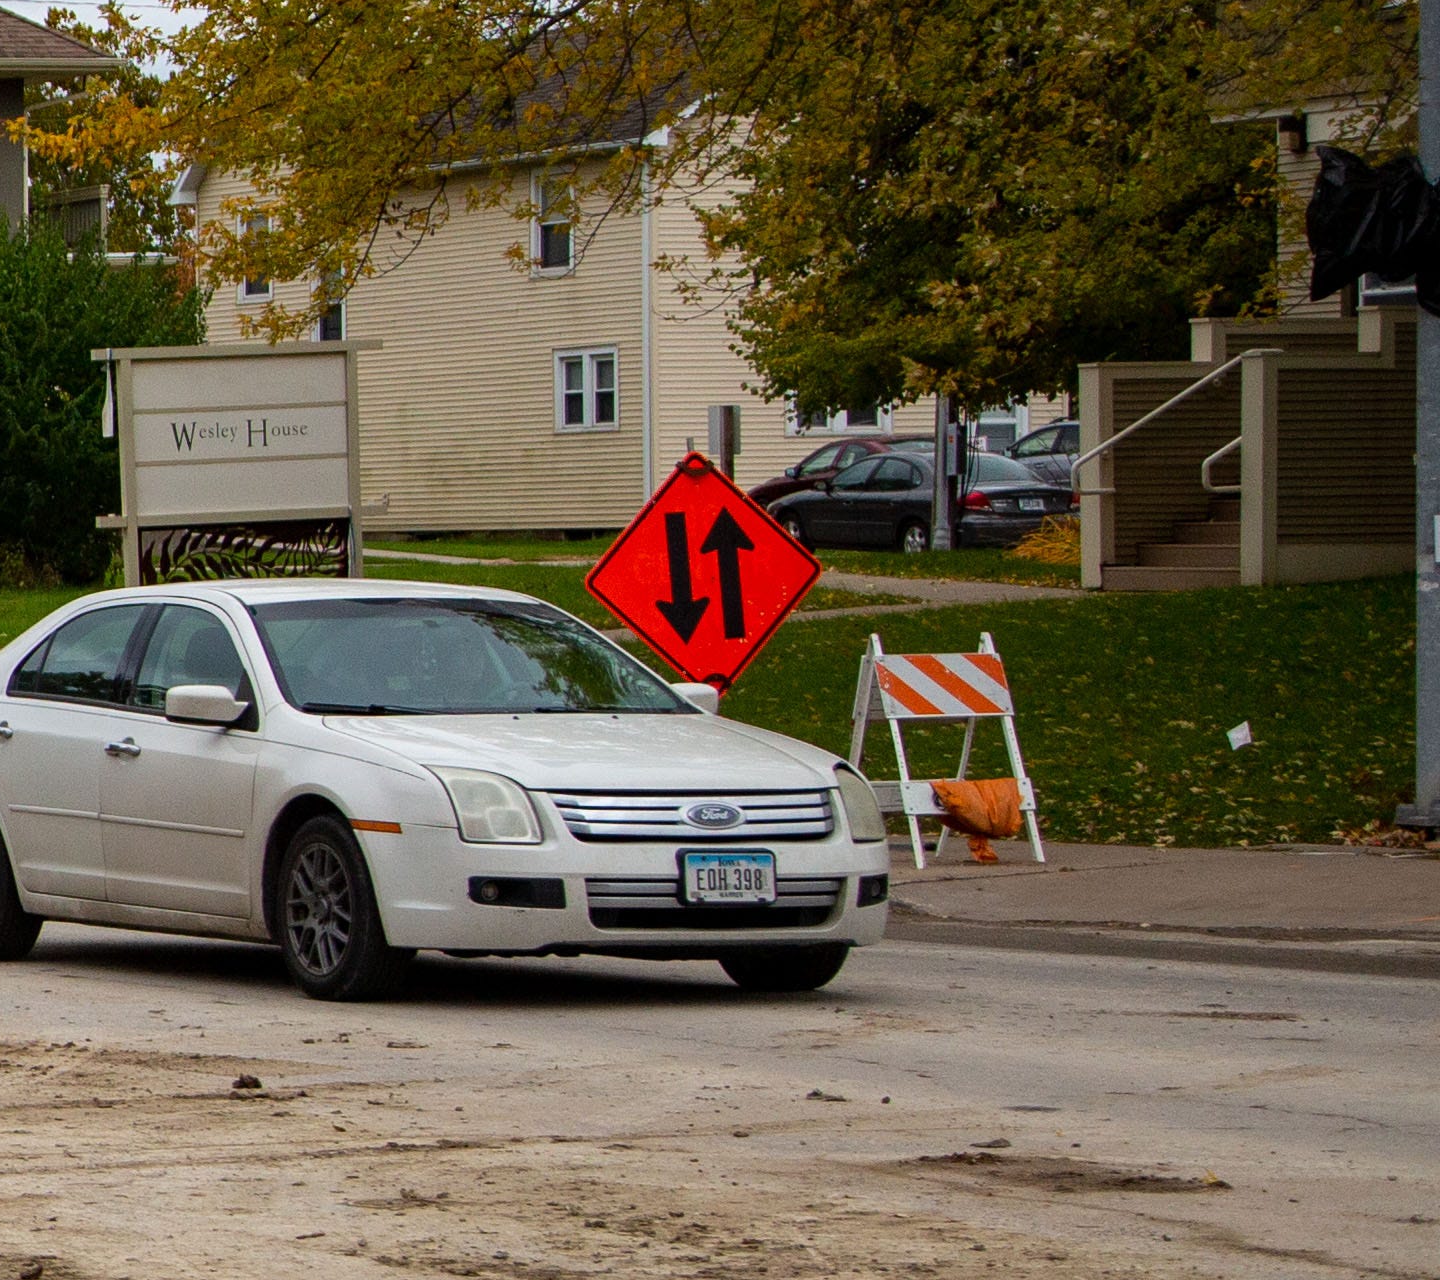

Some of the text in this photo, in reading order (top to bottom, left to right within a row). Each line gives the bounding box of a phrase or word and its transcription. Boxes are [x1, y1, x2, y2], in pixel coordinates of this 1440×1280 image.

[170, 418, 309, 452] Wesley House
[700, 806, 730, 821] Ford
[733, 868, 763, 891] 398
